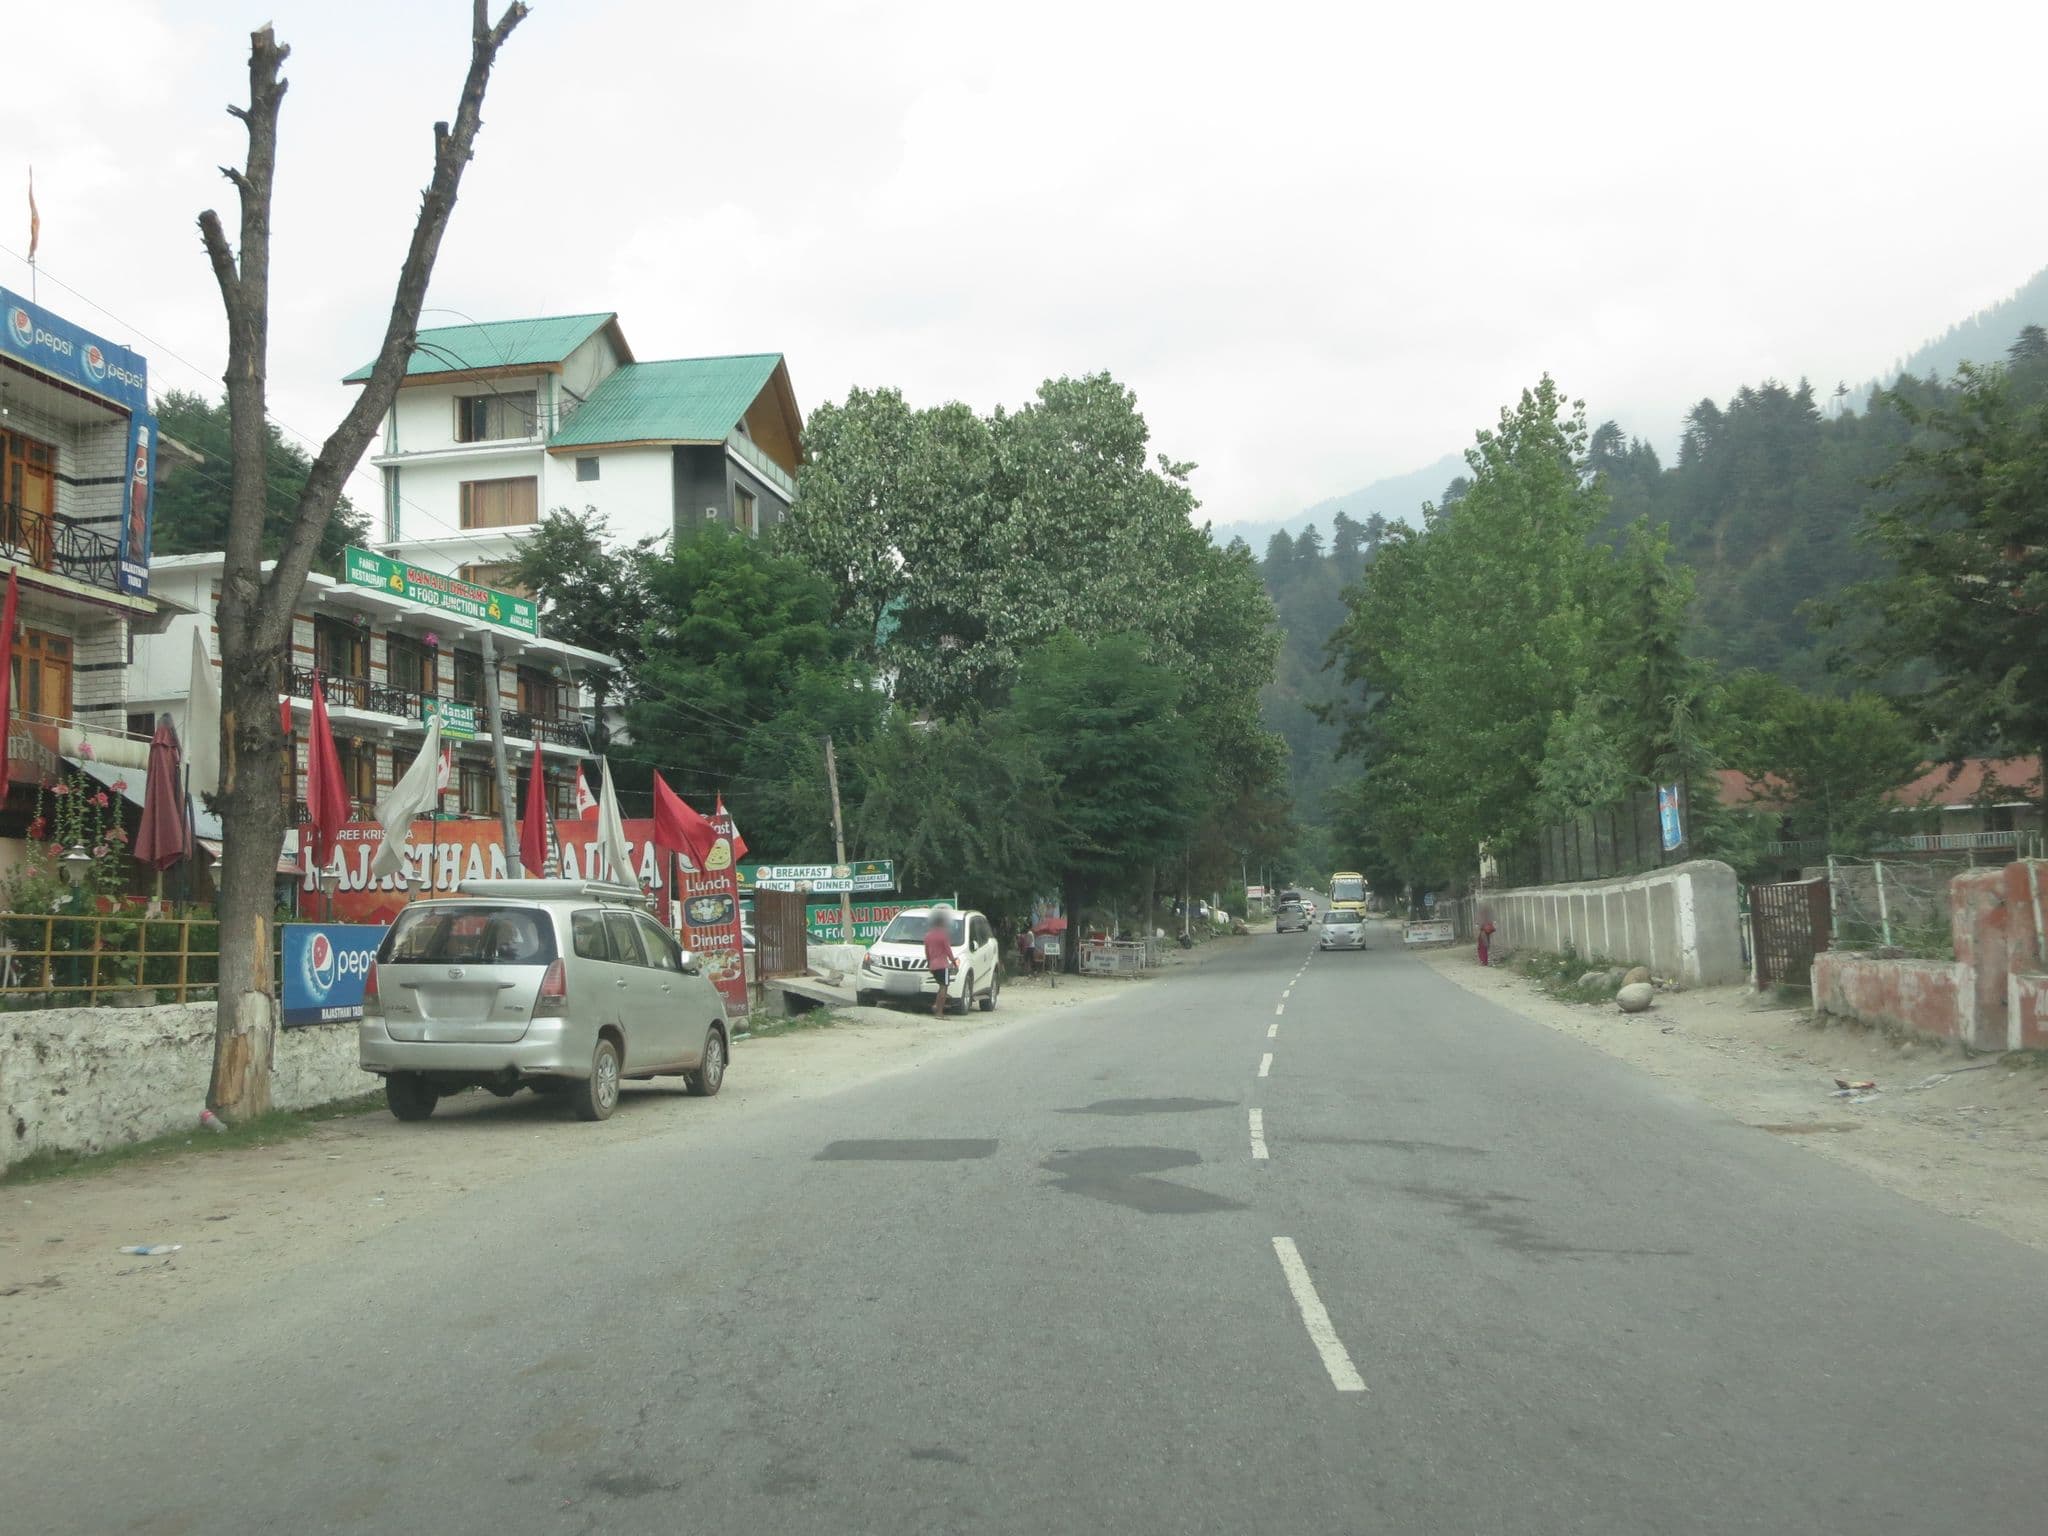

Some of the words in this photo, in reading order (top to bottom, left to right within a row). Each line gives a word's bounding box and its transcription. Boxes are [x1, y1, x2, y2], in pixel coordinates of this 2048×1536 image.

[35, 328, 73, 357] pepsi
[107, 363, 144, 389] pepsi
[359, 557, 380, 573] FAMILY
[351, 568, 387, 588] RESTAURANT
[406, 567, 448, 592] MANALI
[449, 581, 488, 603] DREAMS
[417, 587, 439, 605] FOOD
[440, 595, 479, 617] JUNCTION
[776, 867, 828, 878] BREAKFAST
[686, 875, 730, 892] Lunch
[816, 880, 850, 890] DINNER
[690, 933, 735, 947] Dinner
[826, 927, 856, 939] FOO
[338, 944, 381, 981] peps
